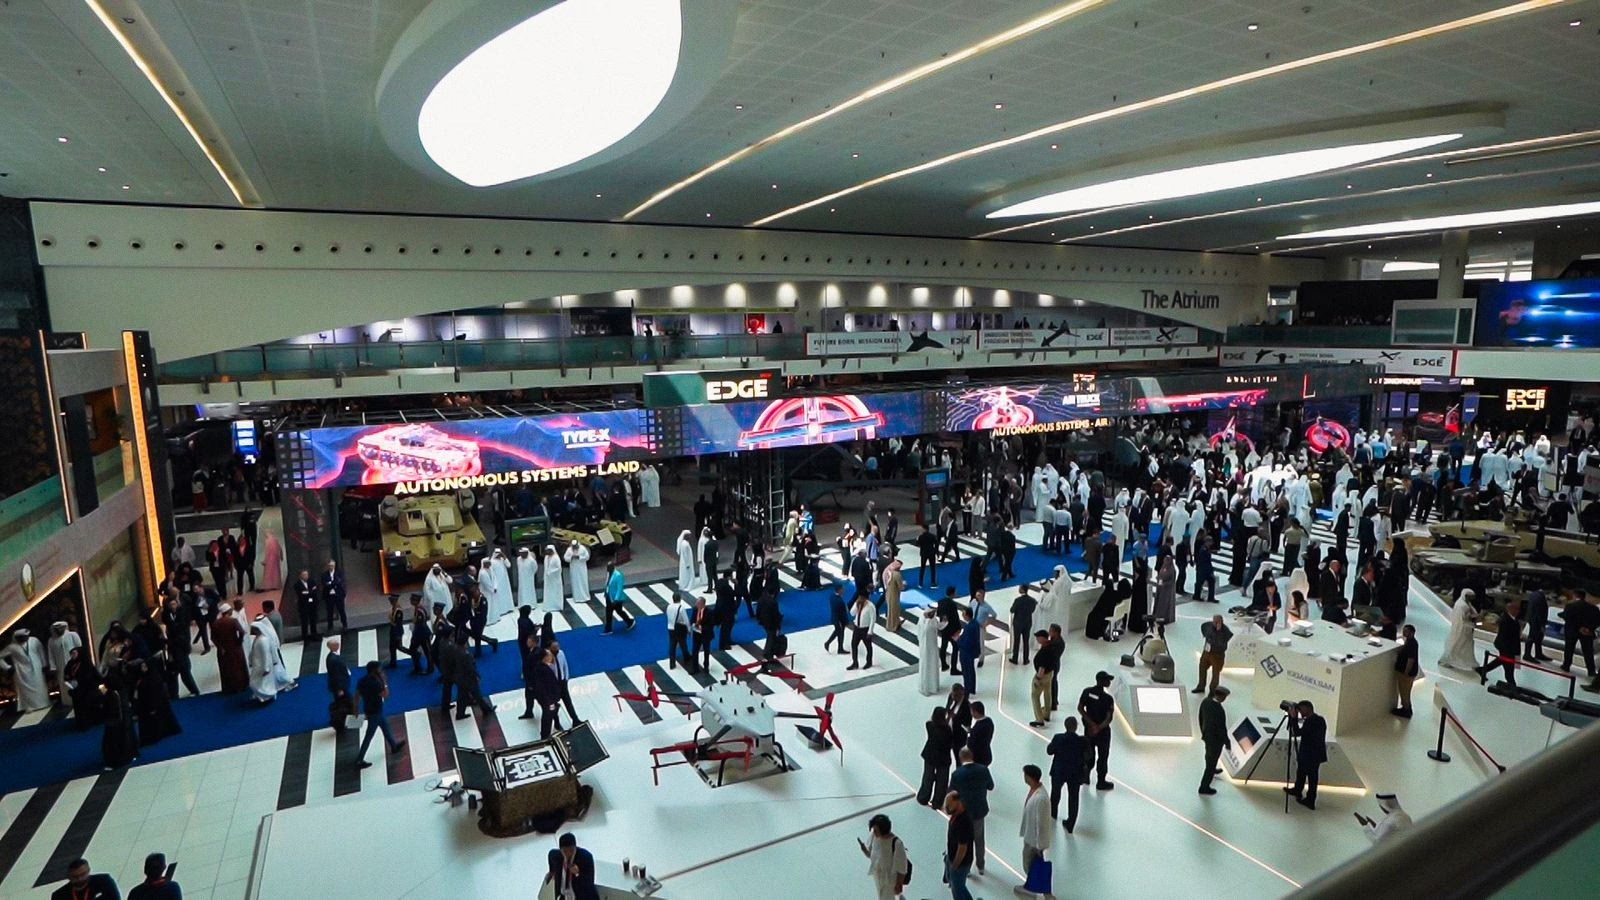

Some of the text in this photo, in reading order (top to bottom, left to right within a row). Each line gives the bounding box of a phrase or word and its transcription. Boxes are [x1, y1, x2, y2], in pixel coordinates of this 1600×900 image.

[1141, 290, 1219, 309] The Atrium
[1223, 353, 1244, 361] EDGE
[1413, 358, 1444, 367] EDGE
[706, 379, 768, 400] EDGE
[1506, 389, 1547, 400] EDGE
[992, 422, 1055, 437] AUTONOMOUS
[1056, 419, 1090, 431] SYSTEMS
[1094, 418, 1109, 427] AIR
[394, 471, 518, 495] AUTONOMOUS
[522, 465, 587, 483] SYSTEMS
[598, 461, 640, 476] LAND
